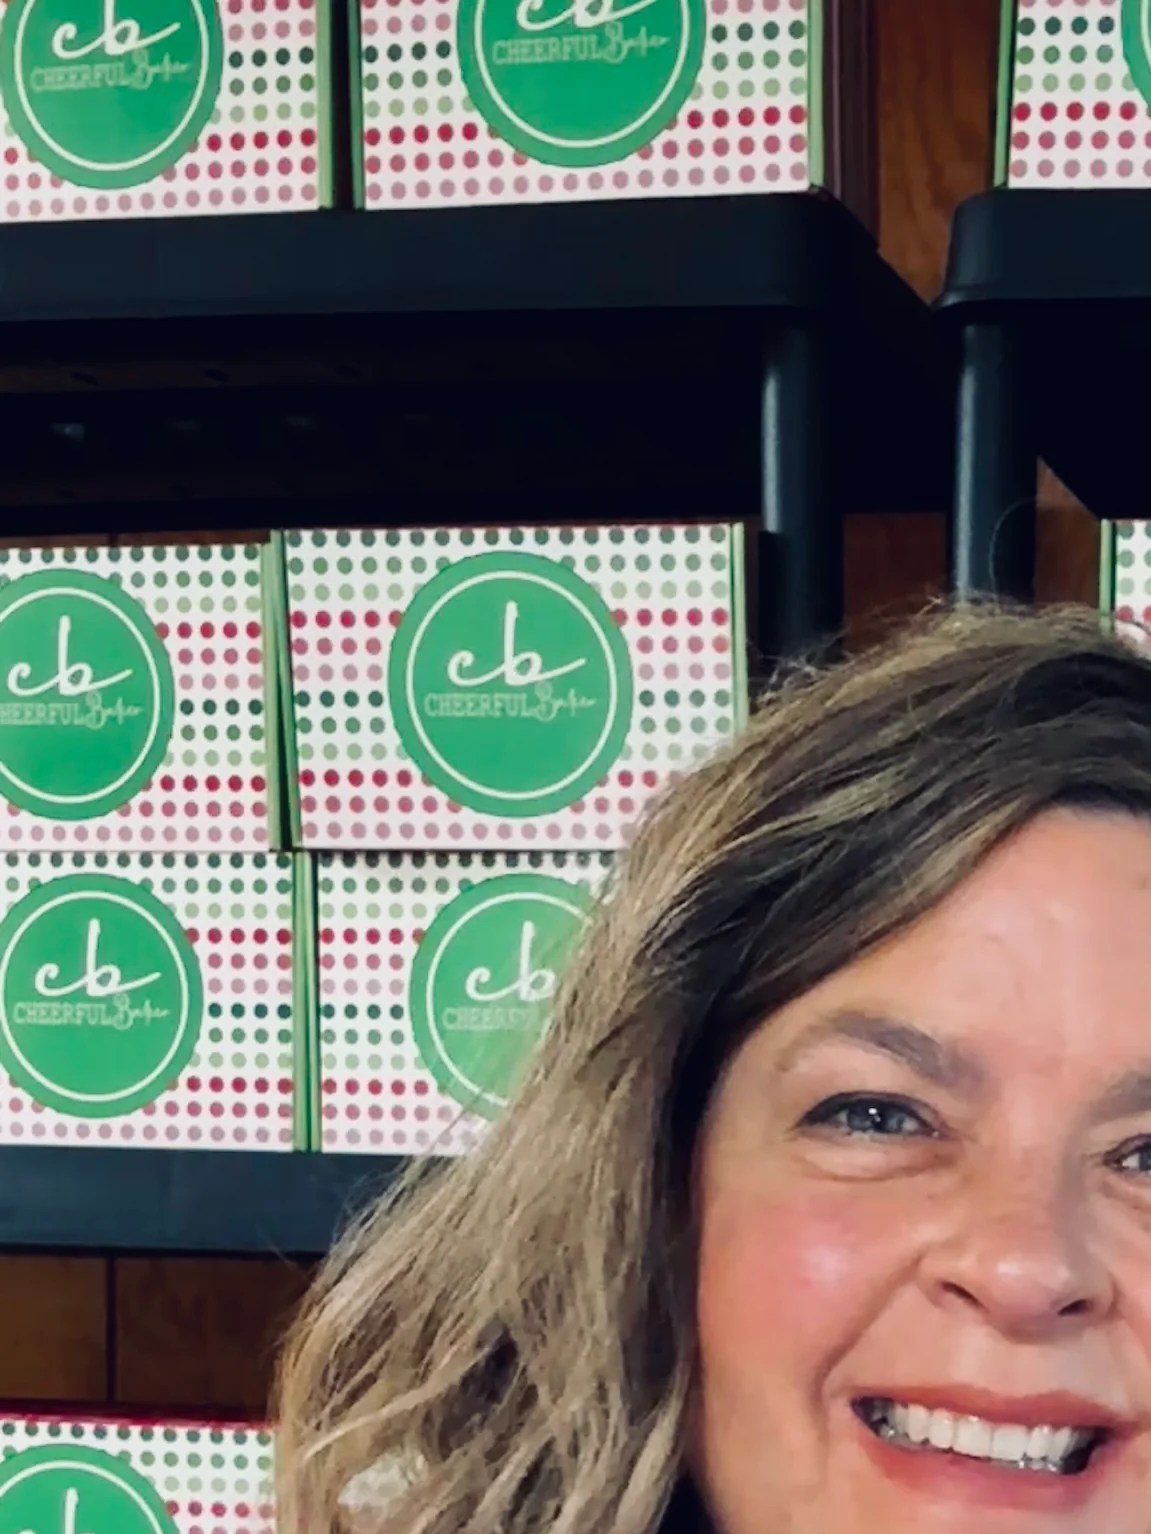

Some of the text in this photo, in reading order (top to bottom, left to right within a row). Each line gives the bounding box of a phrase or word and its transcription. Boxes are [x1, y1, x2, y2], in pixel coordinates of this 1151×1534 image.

[492, 35, 603, 64] CHEERFUL
[30, 61, 132, 92] CHEERFUL
[7, 615, 133, 696] cb
[447, 601, 587, 686] cb
[424, 692, 528, 718] CHEERFUL
[35, 918, 161, 997] cb
[13, 1002, 112, 1026] CHEERFUL
